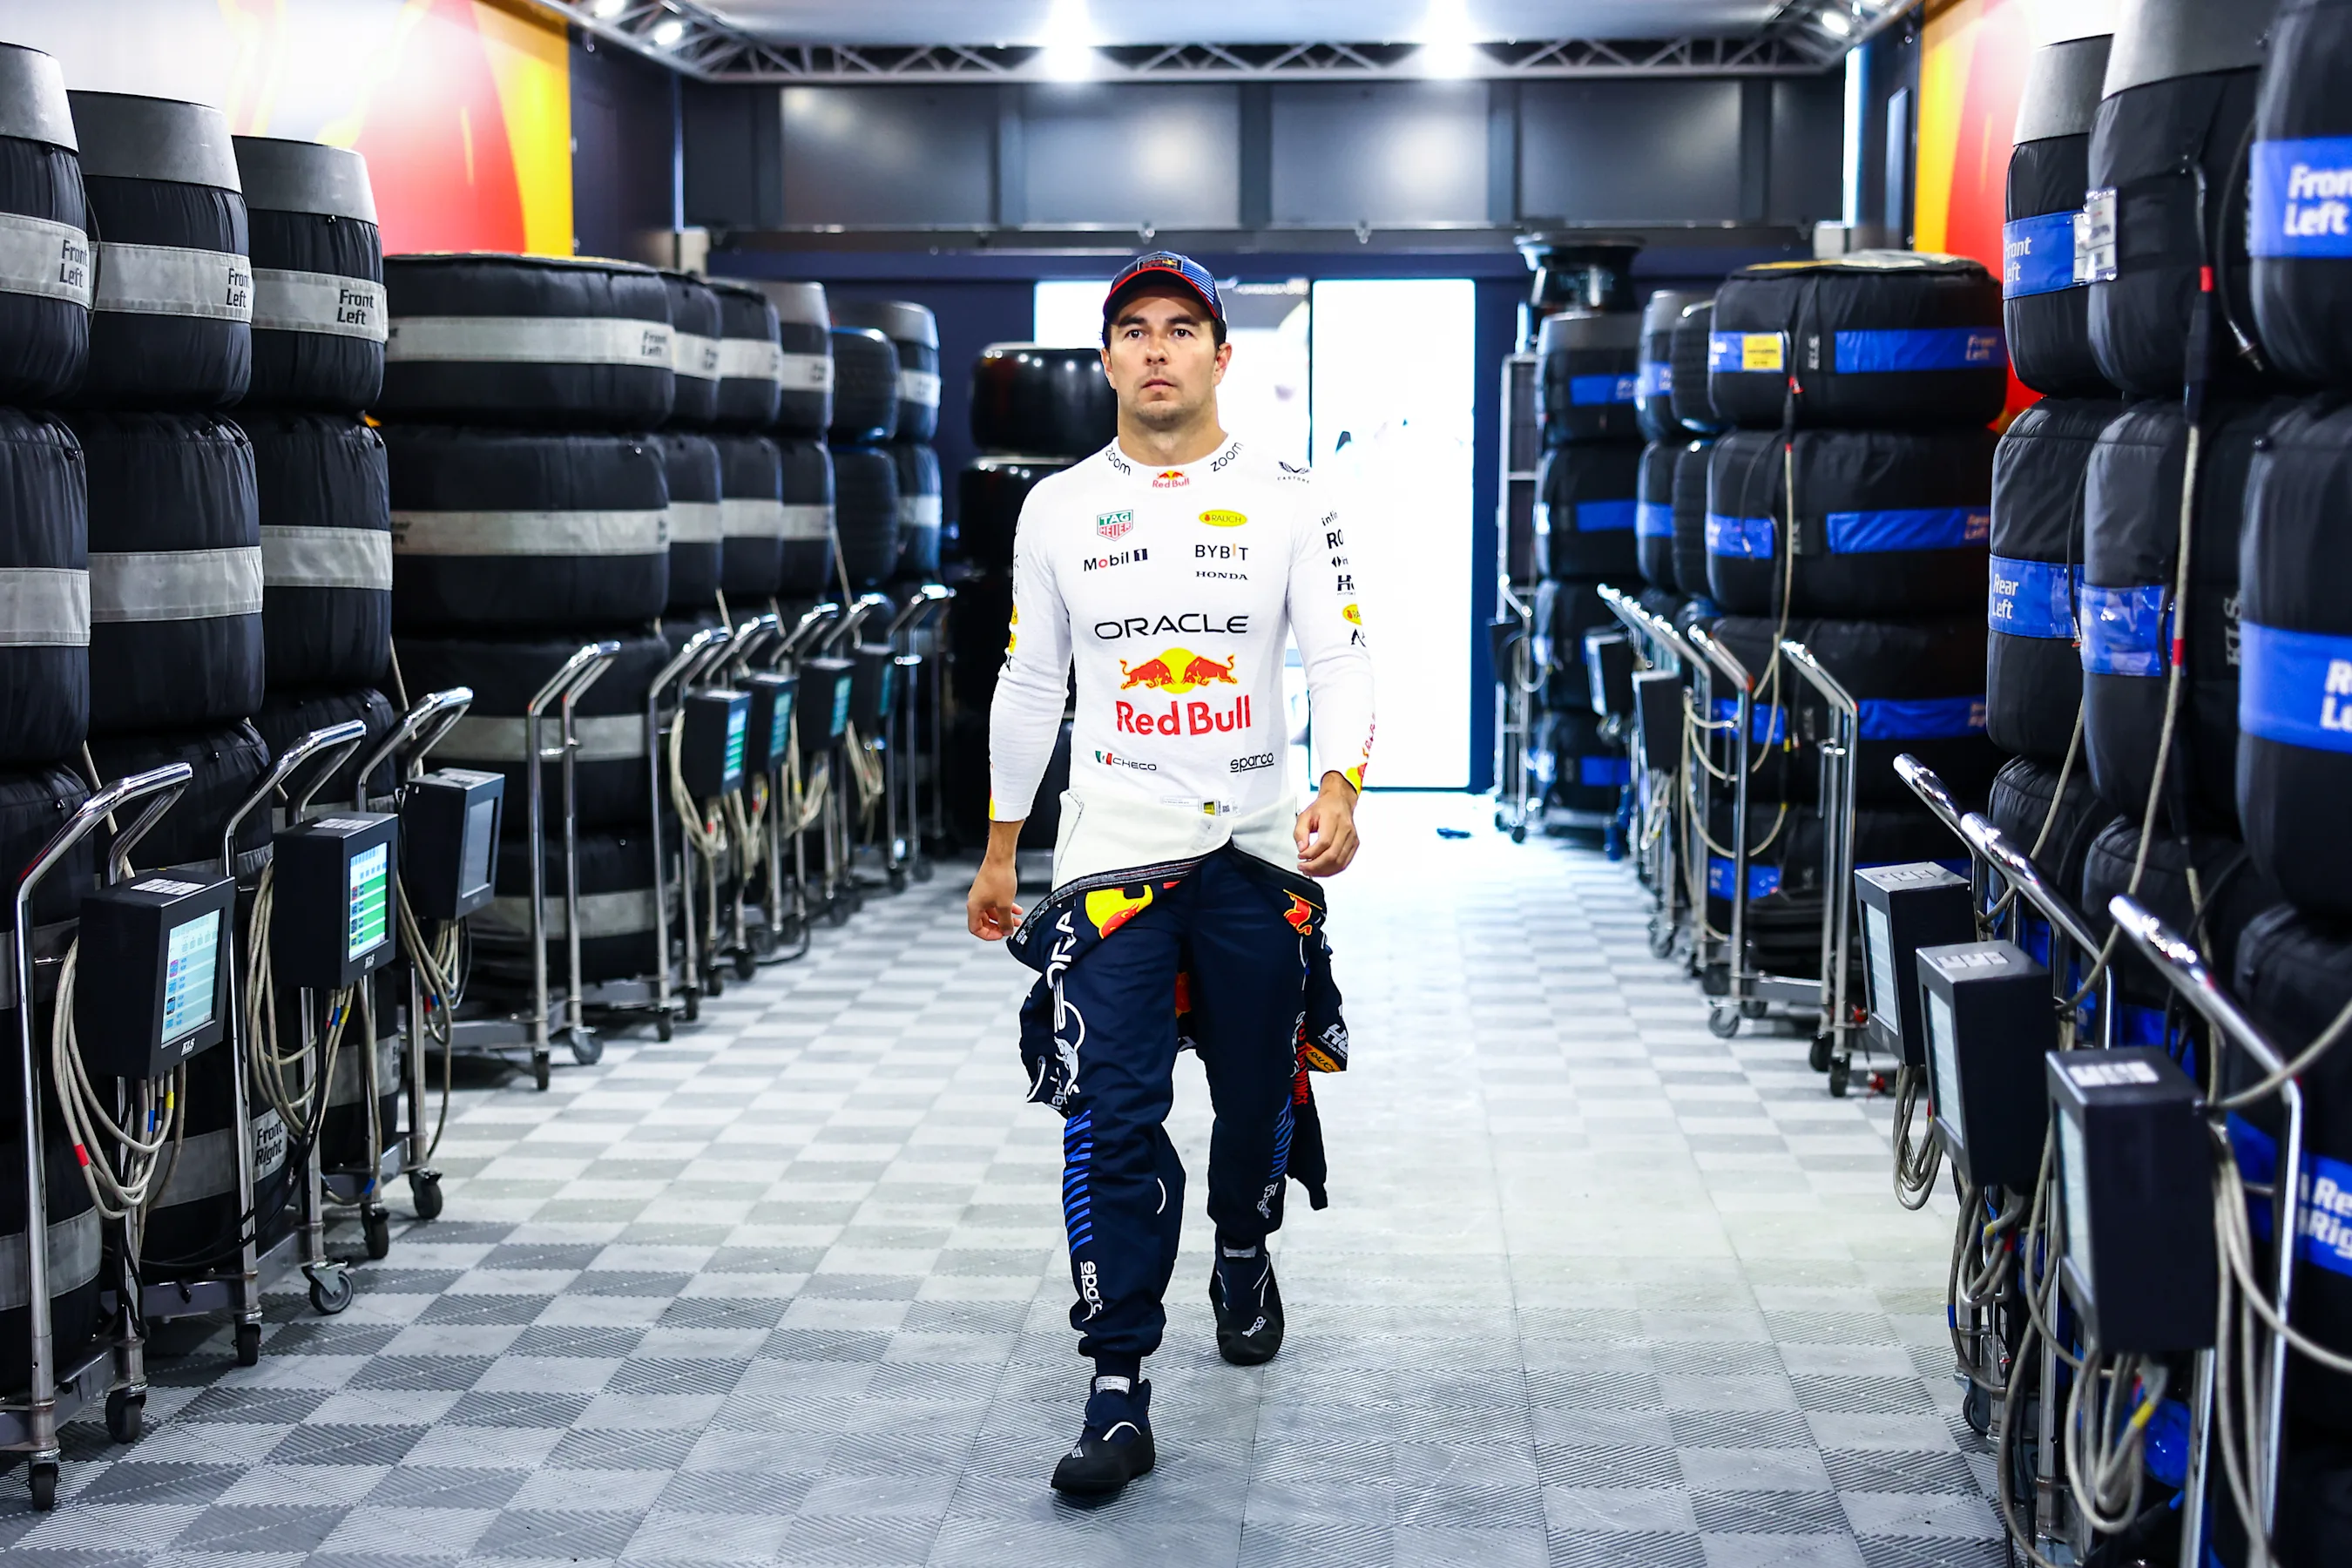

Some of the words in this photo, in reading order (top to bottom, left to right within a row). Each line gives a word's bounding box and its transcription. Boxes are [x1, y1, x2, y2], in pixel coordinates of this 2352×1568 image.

[2283, 201, 2349, 236] Left
[61, 240, 88, 267] Front
[59, 264, 84, 288] Left
[228, 268, 250, 288] Front
[226, 288, 247, 308] Left
[339, 288, 375, 308] Front
[337, 307, 366, 325] Left
[1105, 447, 1131, 476] zoom
[1210, 442, 1244, 471] zoom
[1152, 480, 1171, 489] Red
[1172, 478, 1190, 488] Bull
[1099, 512, 1131, 525] TAG
[1211, 514, 1242, 524] RAUCH
[1099, 523, 1132, 539] HEUER
[1084, 551, 1130, 572] Mobil
[1134, 549, 1148, 562] 1
[1195, 544, 1249, 561] BYBIT
[1195, 571, 1248, 580] HONDA
[1336, 575, 1355, 591] H
[1993, 573, 2019, 597] Rear
[1991, 598, 2014, 620] Left
[1094, 613, 1249, 640] ORACLE
[1116, 700, 1180, 735] Red
[1186, 694, 1251, 736] Bull
[1112, 757, 1157, 771] CHECO
[1230, 753, 1274, 774] sparco
[256, 1119, 283, 1146] Front
[254, 1140, 282, 1166] Right
